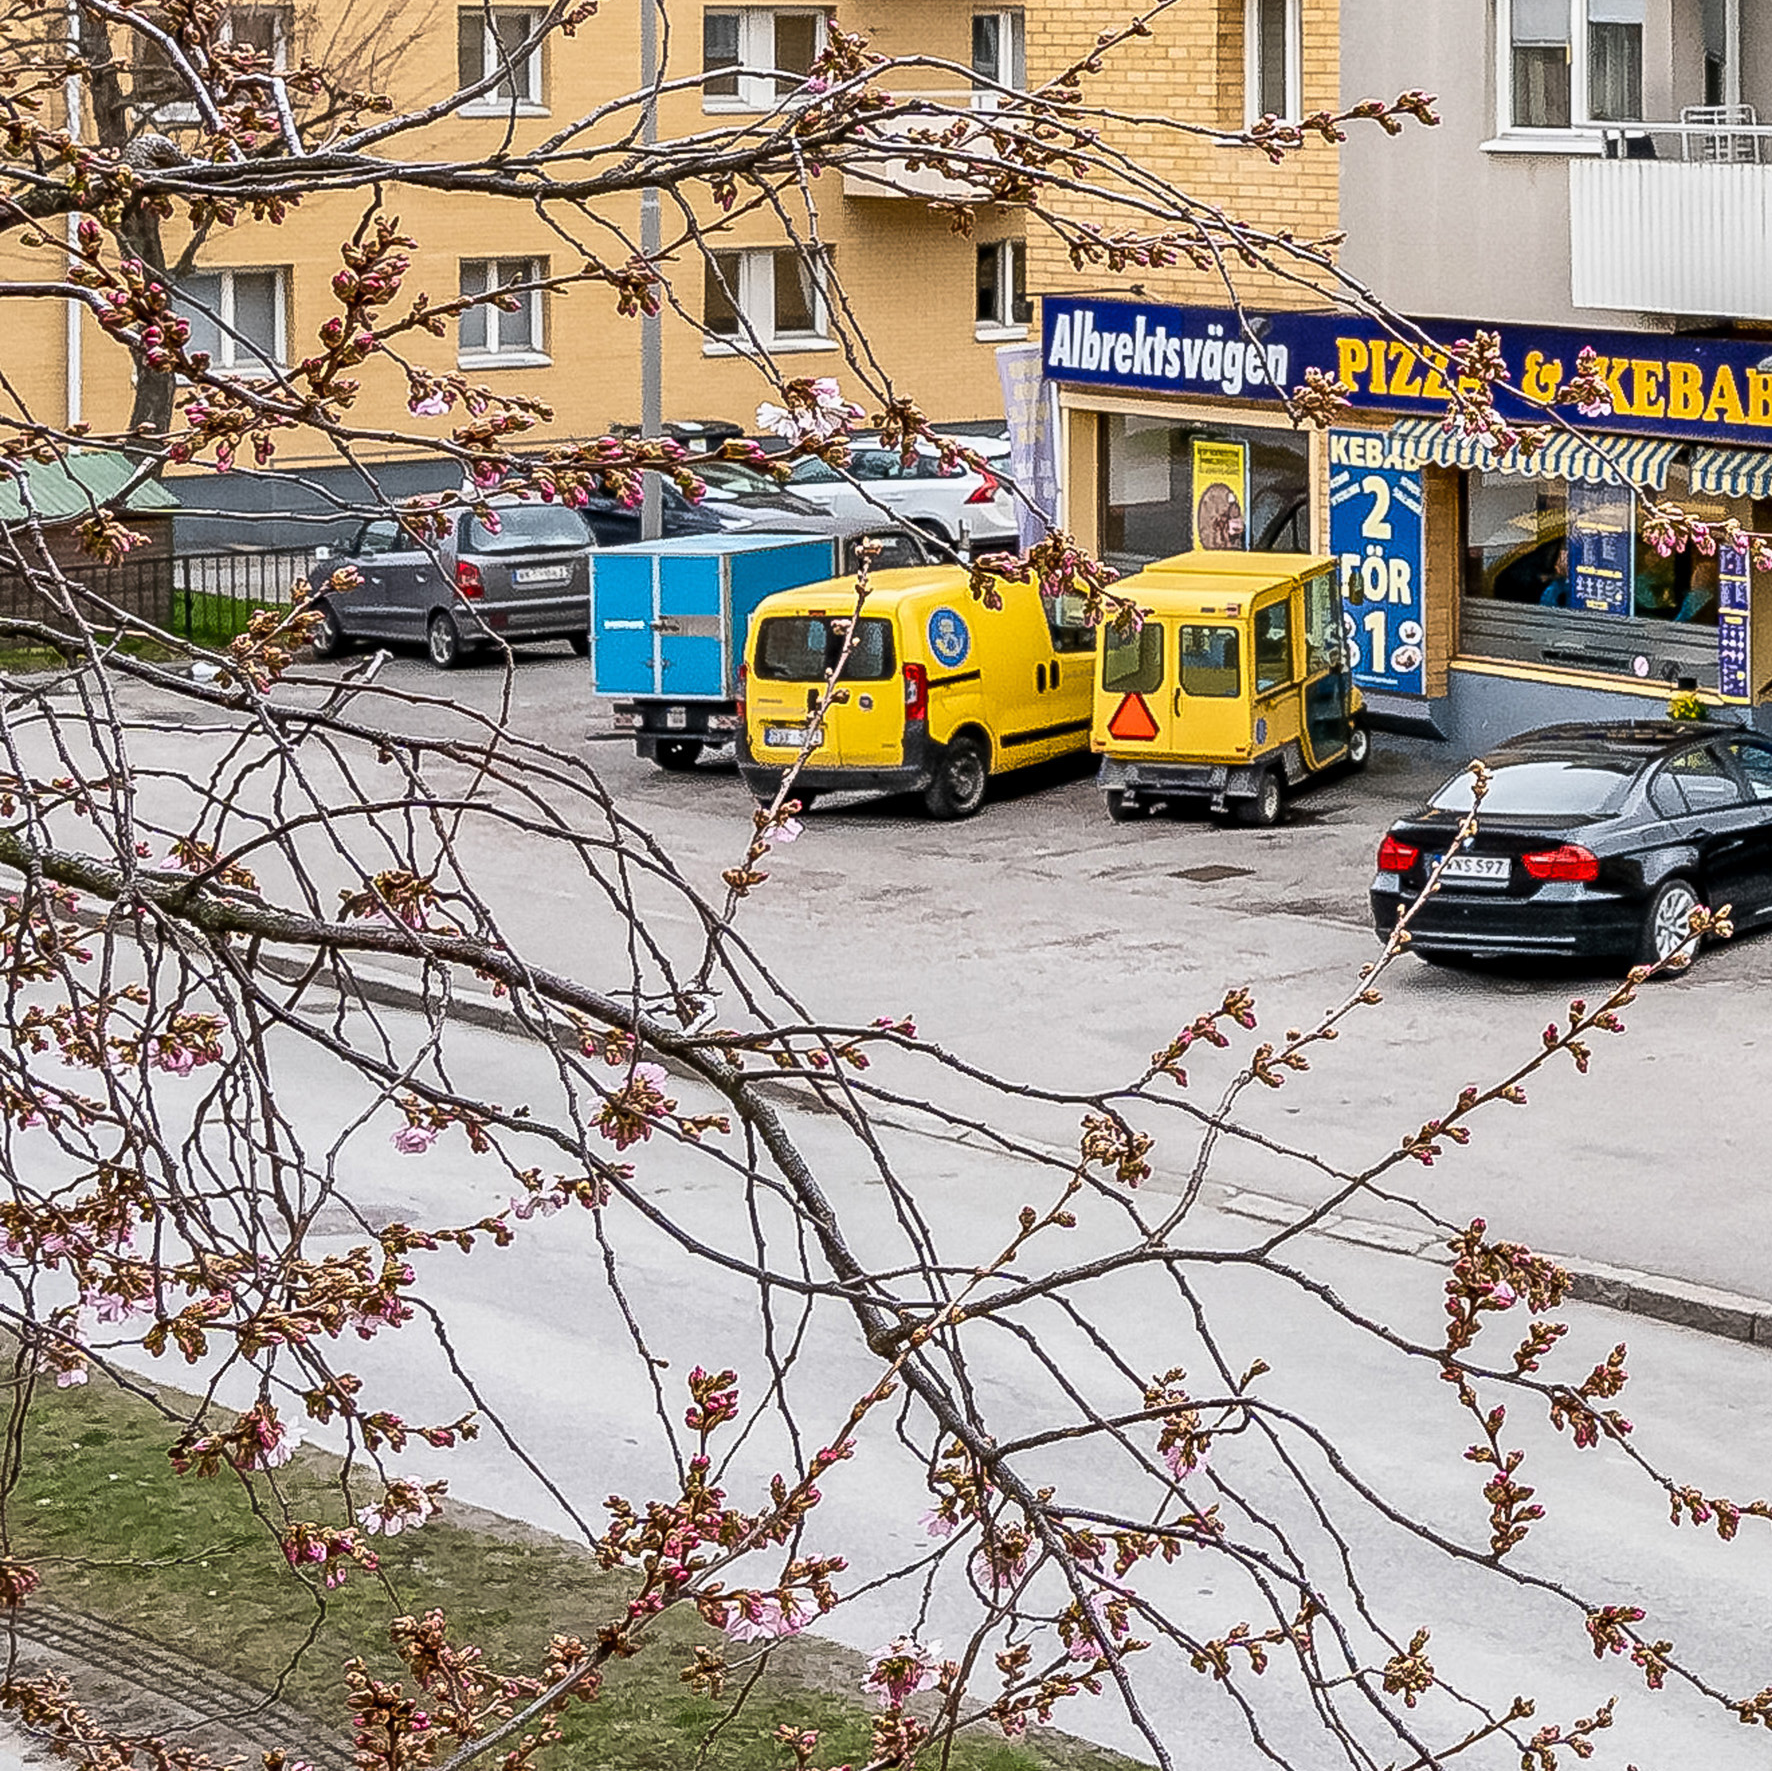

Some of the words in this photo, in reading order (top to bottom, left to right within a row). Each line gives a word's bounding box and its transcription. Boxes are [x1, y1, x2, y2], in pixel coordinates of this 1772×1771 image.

[1048, 309, 1288, 395] Albrektsvägen
[1336, 337, 1487, 401] PIZZ
[1522, 350, 1563, 403] &
[1362, 475, 1392, 540] 2
[1340, 544, 1412, 606] FÖR
[1363, 610, 1386, 674] 1
